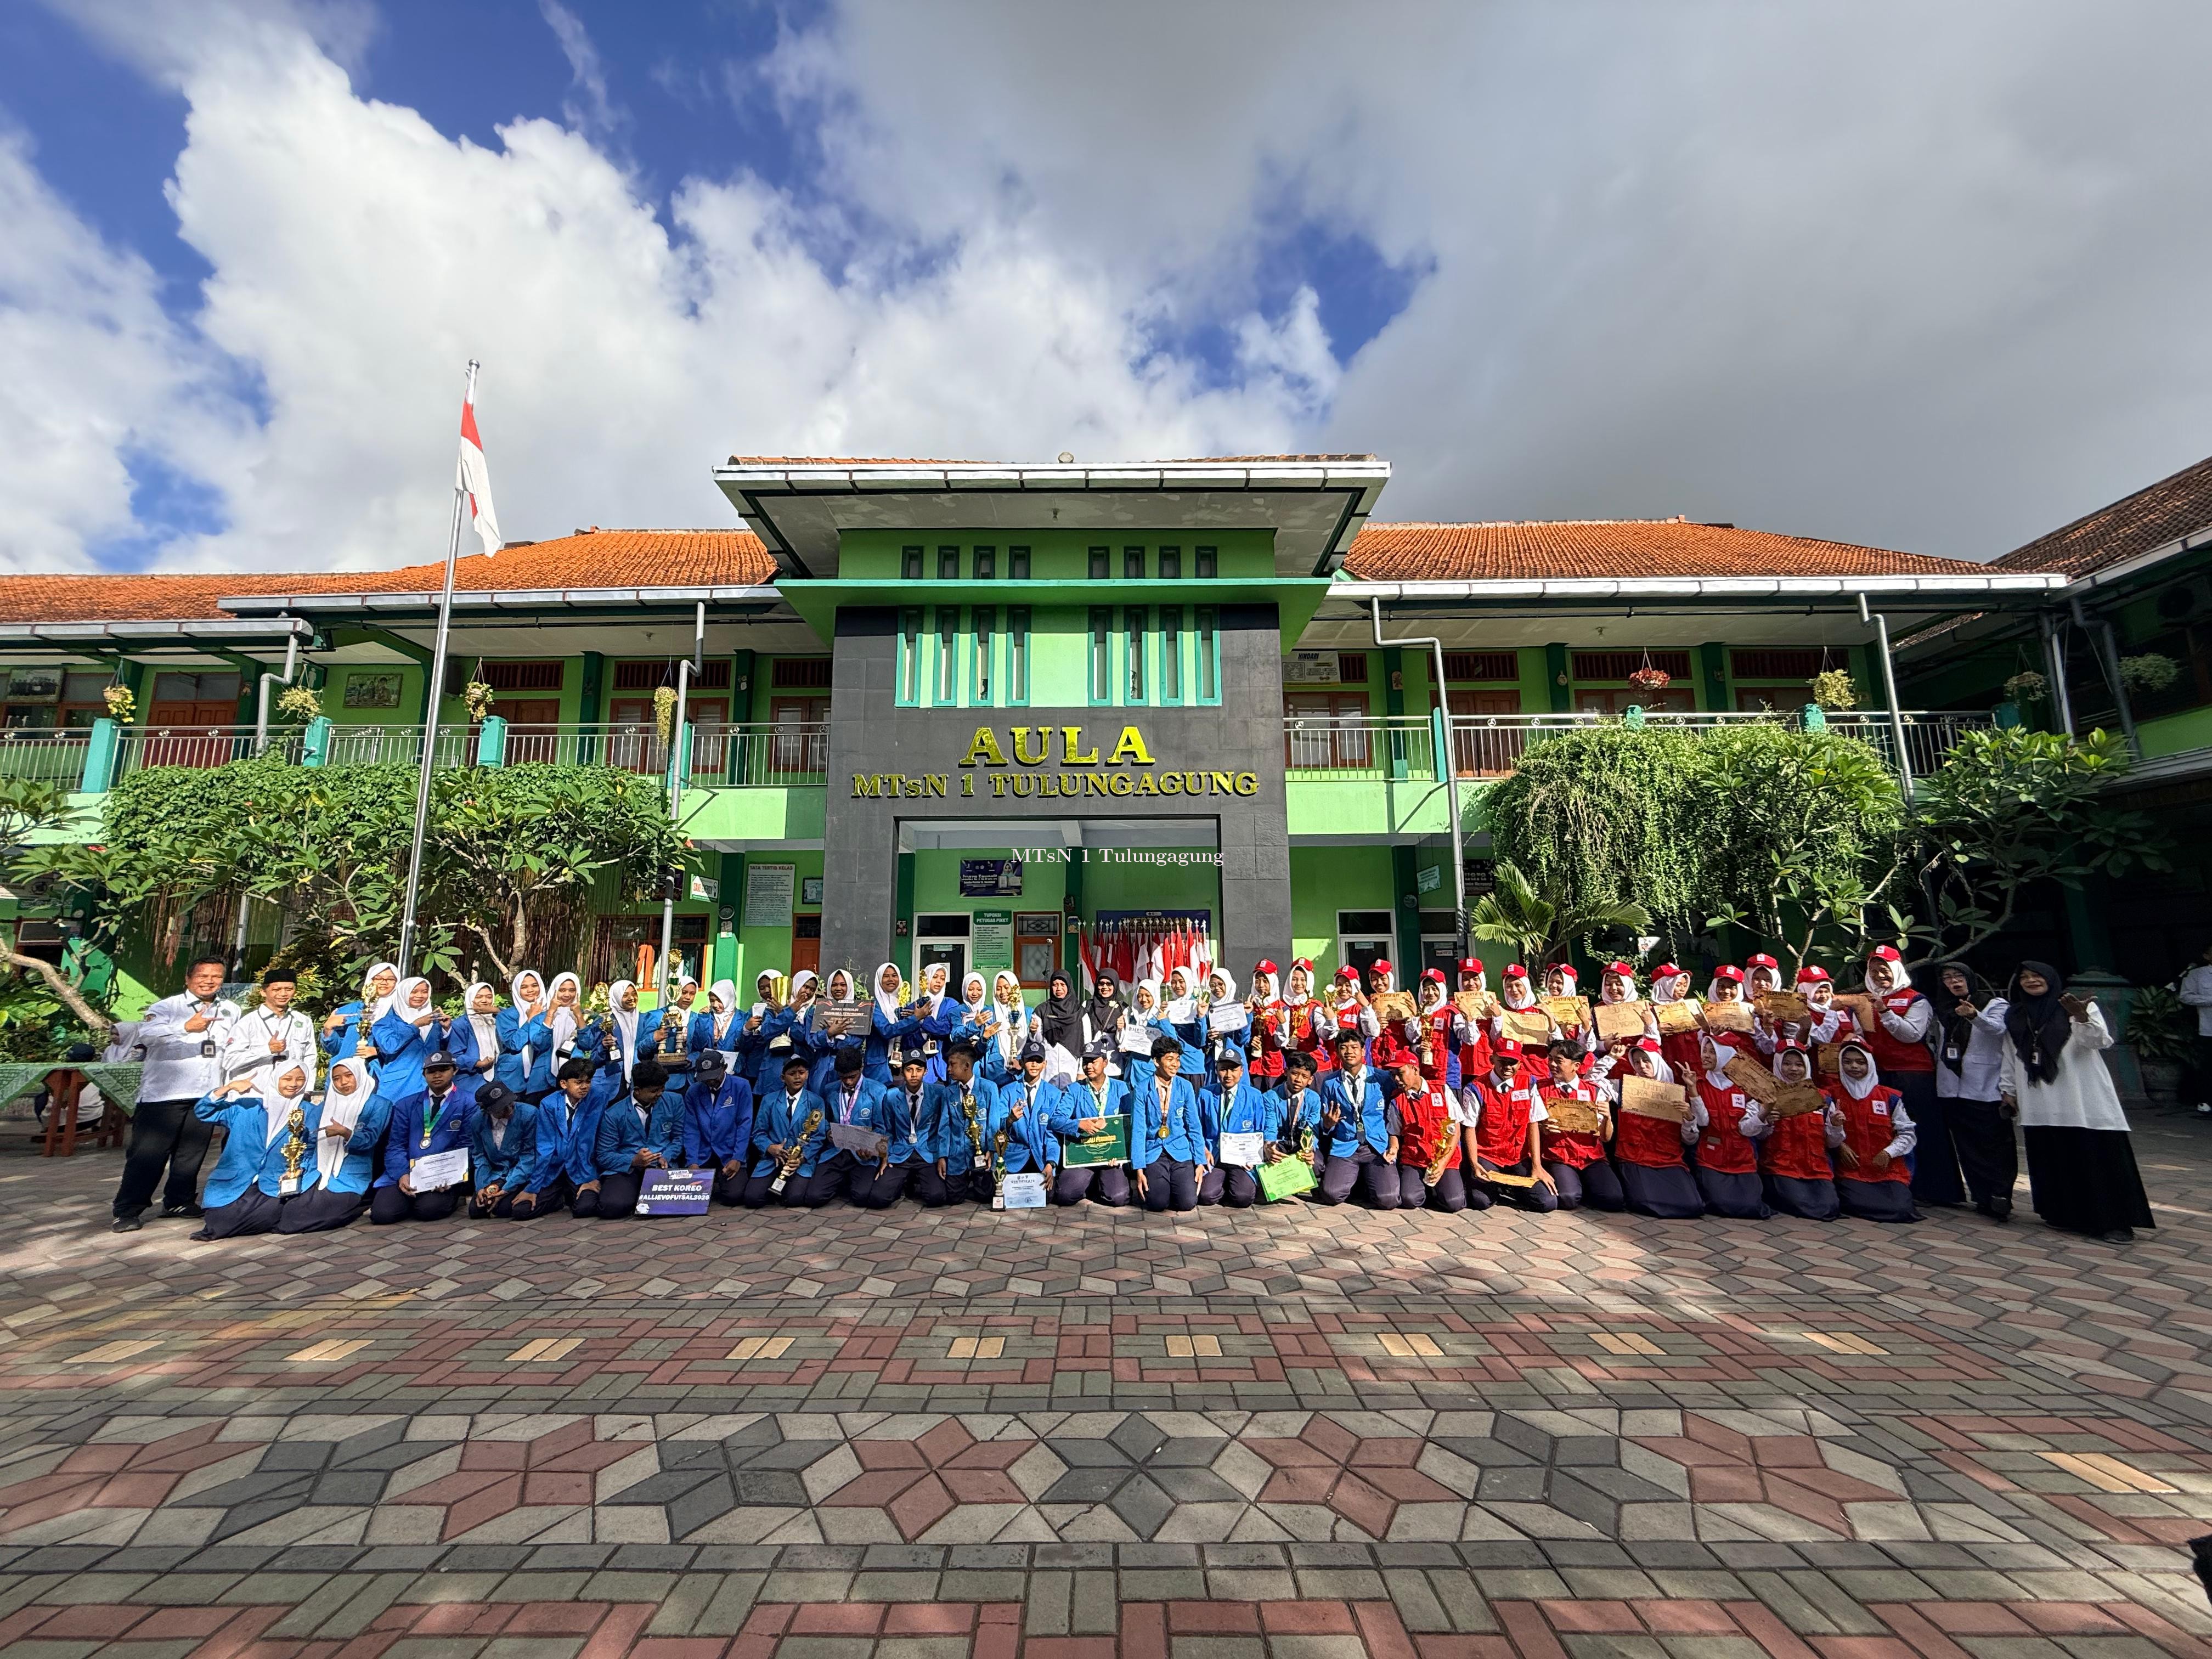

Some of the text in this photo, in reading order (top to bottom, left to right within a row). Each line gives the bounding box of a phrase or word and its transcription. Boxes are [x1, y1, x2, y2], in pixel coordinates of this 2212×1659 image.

[960, 727, 1156, 764] AULA
[851, 771, 1260, 797] MTsN 1 TULUNGAGUNG
